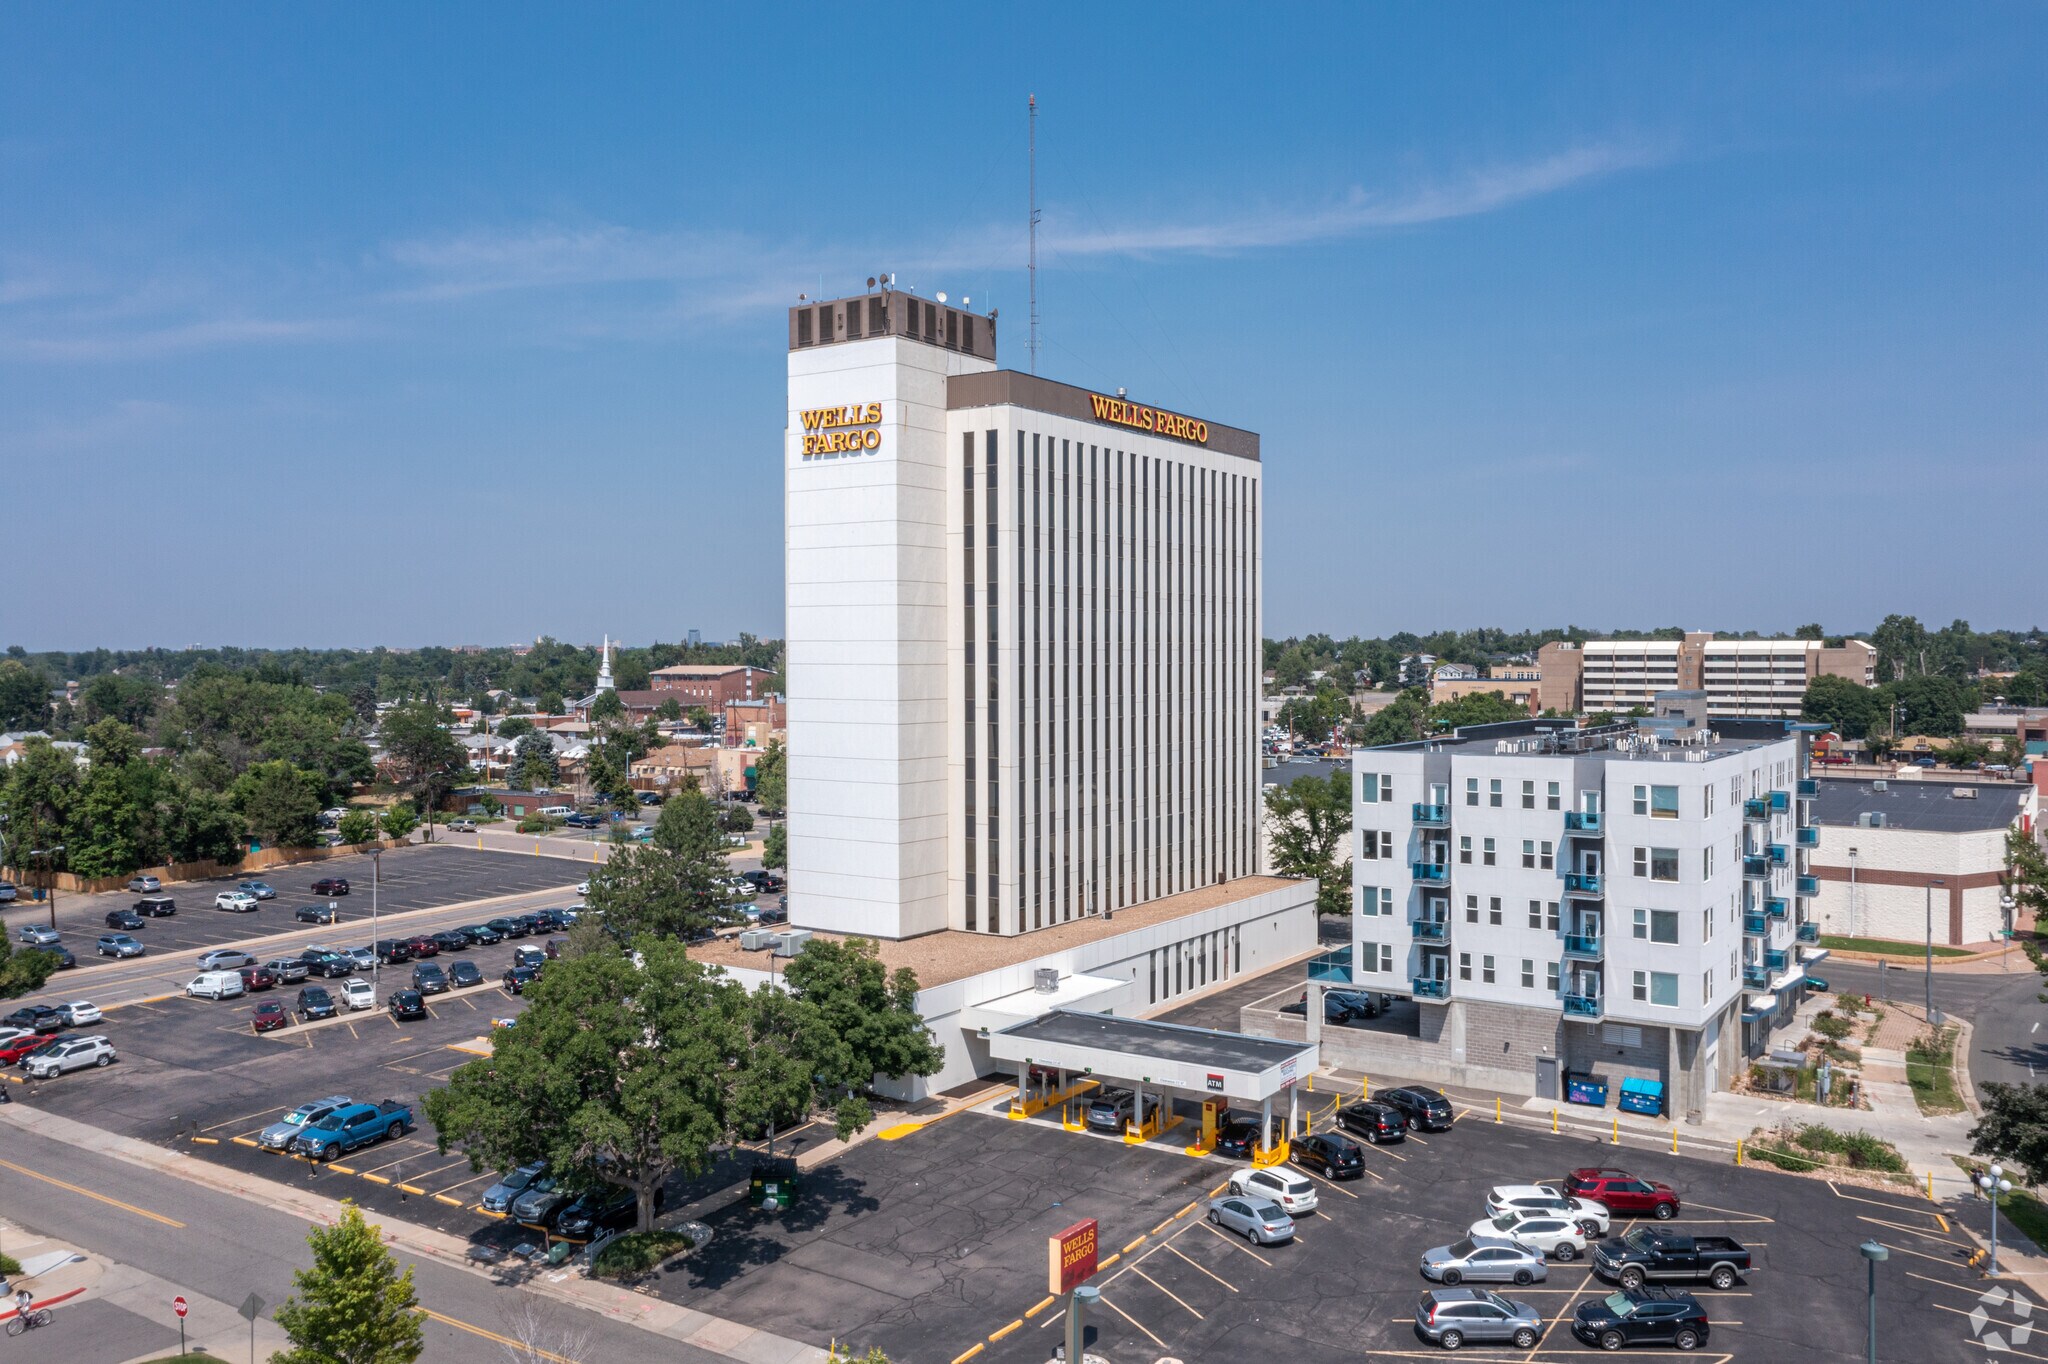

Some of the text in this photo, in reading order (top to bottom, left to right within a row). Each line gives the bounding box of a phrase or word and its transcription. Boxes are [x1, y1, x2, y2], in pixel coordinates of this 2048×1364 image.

[800, 402, 882, 430] WELLS
[1089, 394, 1208, 443] WELLS FARGO
[802, 428, 881, 455] FARGO
[1207, 1079, 1222, 1088] ATM
[1063, 1228, 1095, 1254] WELLS
[1063, 1241, 1095, 1268] FARGO
[174, 1301, 187, 1312] STOP
